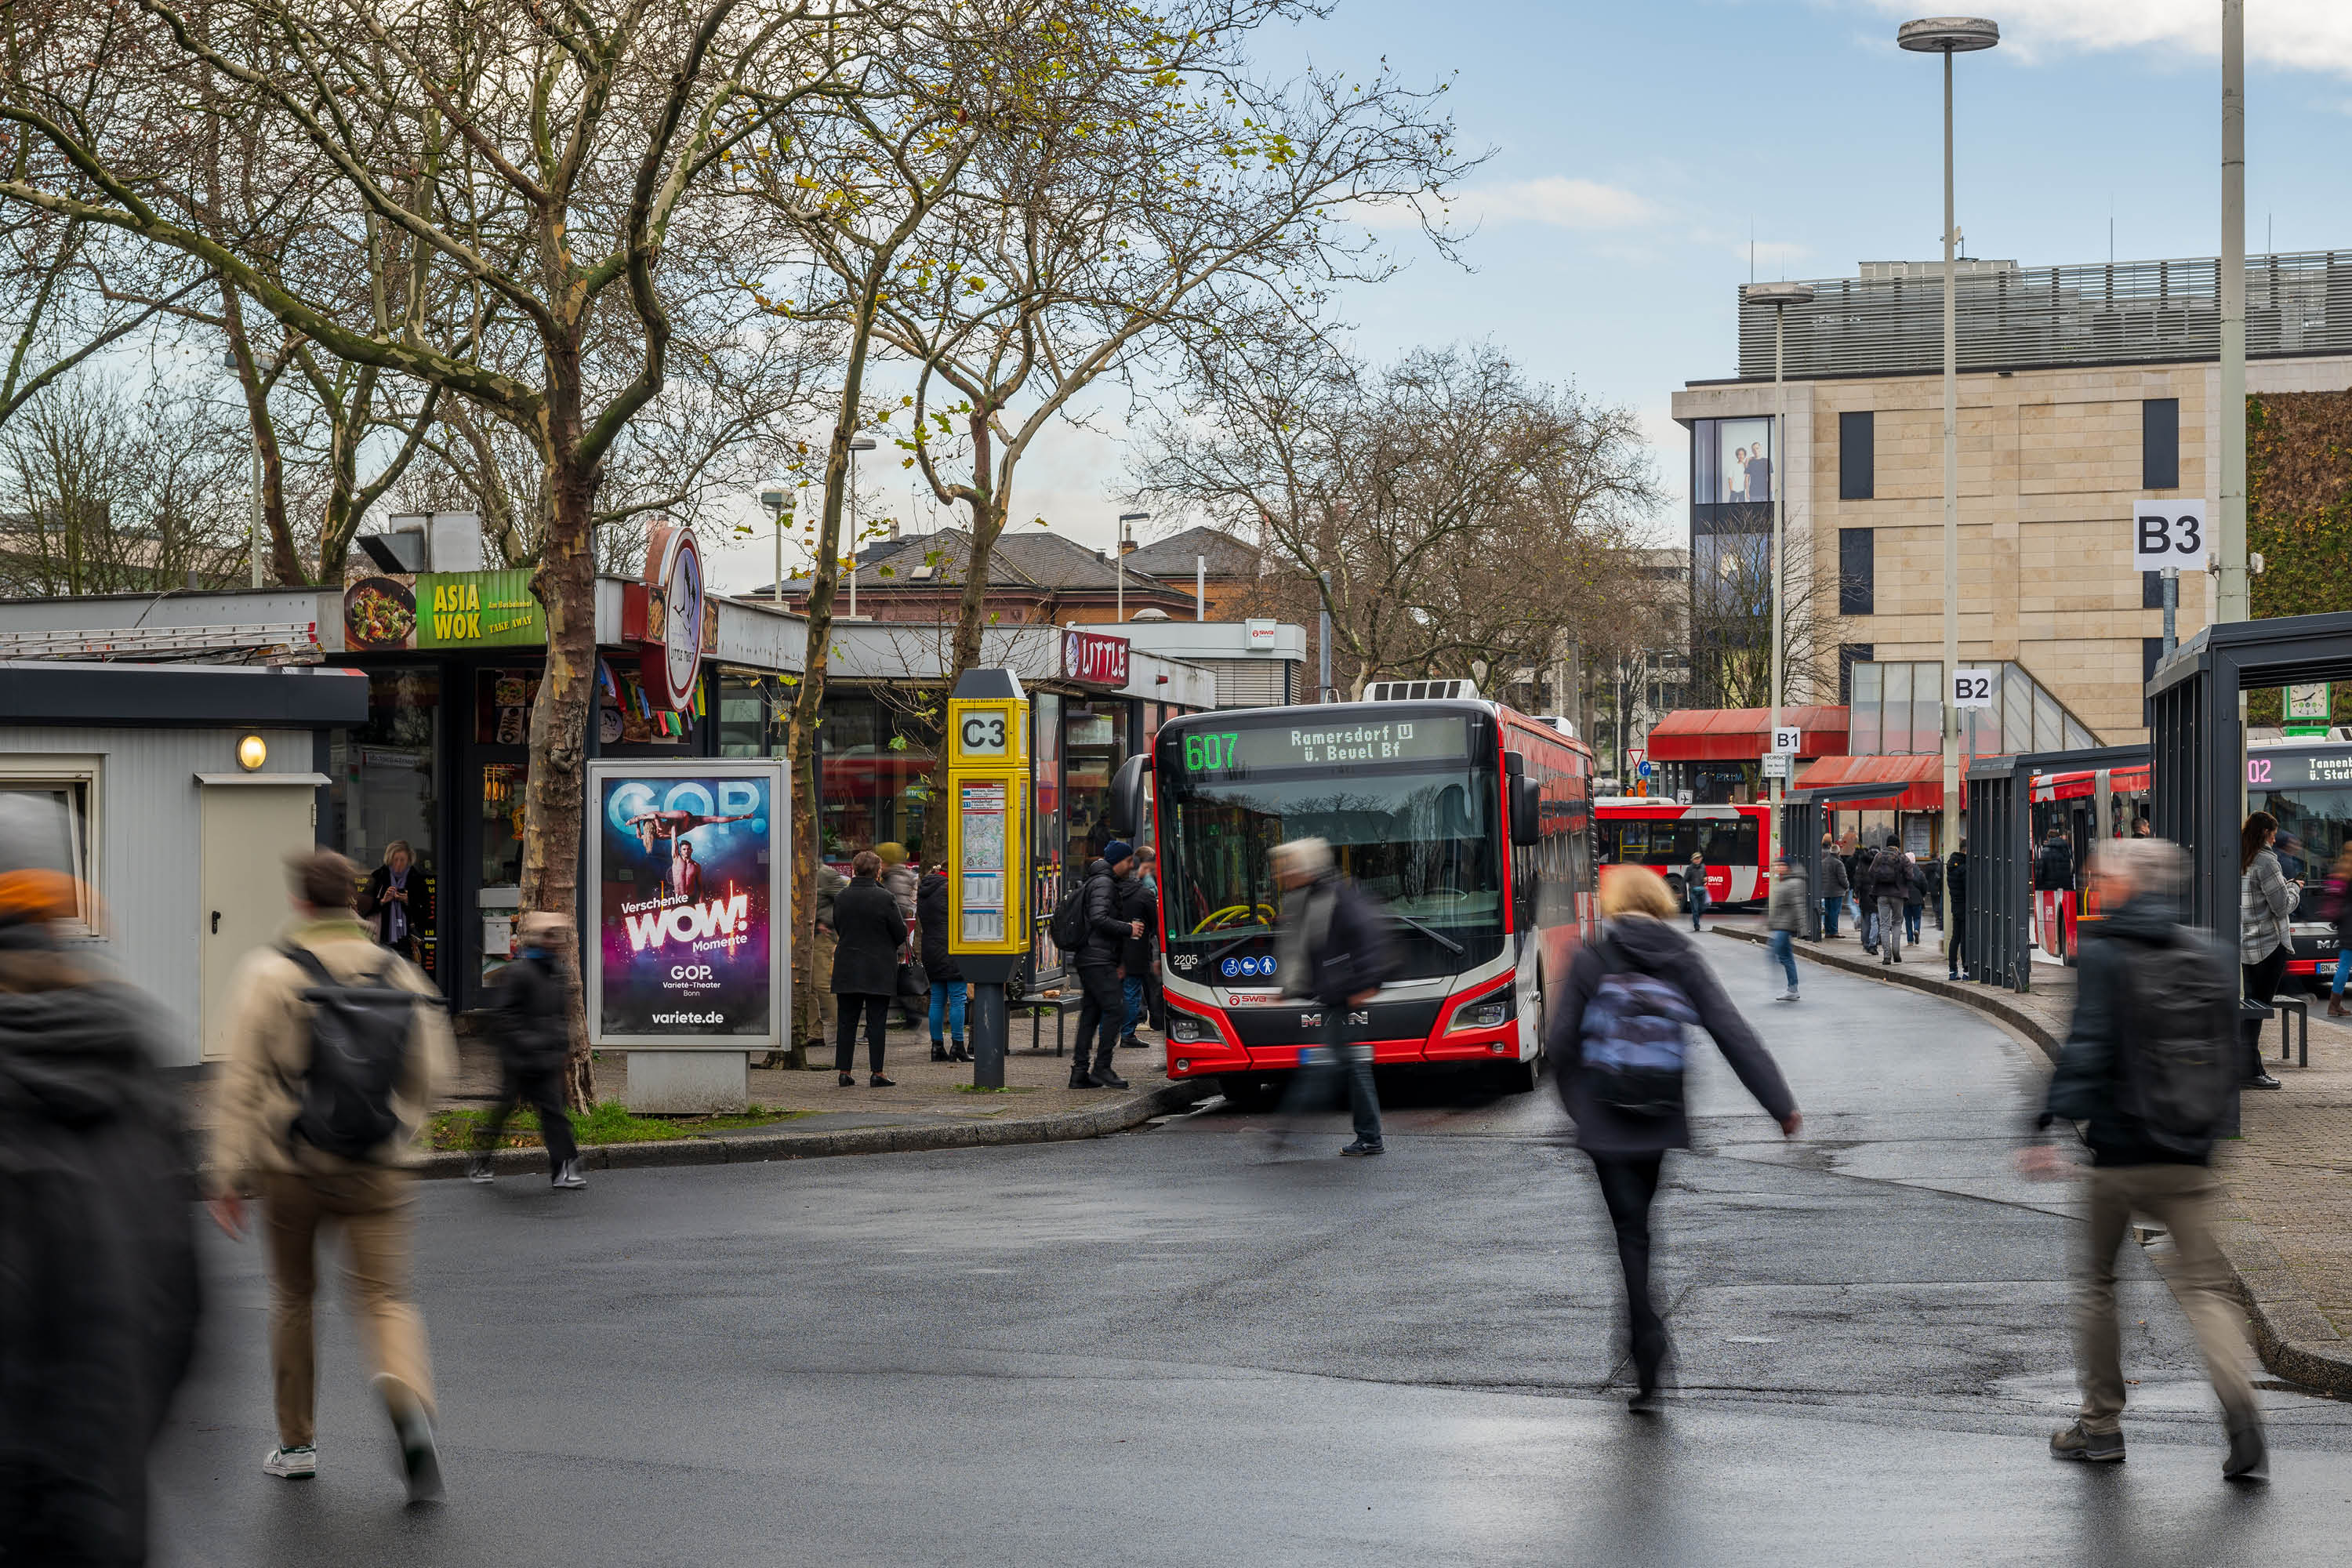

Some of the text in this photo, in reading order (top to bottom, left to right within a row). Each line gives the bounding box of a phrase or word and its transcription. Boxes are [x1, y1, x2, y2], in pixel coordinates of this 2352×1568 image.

[2139, 515, 2201, 554] B3
[433, 584, 481, 612] ASIA
[433, 613, 481, 640] WOK
[488, 615, 532, 633] TAKE AWAY
[1082, 639, 1125, 677] LITTLE
[1956, 678, 1988, 699] B2
[962, 719, 1005, 748] C3
[1777, 733, 1798, 747] B1
[1185, 733, 1238, 771] 607
[1291, 725, 1388, 746] Ramersdorf
[1305, 741, 1399, 762] ü. Beuel Bf
[2247, 759, 2272, 783] 02
[608, 782, 767, 836] GOP.
[621, 893, 688, 914] Verschenke
[625, 894, 748, 951] WOW!
[692, 934, 748, 953] Momente
[2316, 940, 2339, 949] MA
[1174, 954, 1198, 965] 2205
[670, 965, 713, 980] GOP.
[662, 981, 720, 989] Varieté-Theater
[652, 1011, 724, 1025] variete.de
[1301, 1011, 1368, 1027] MN
